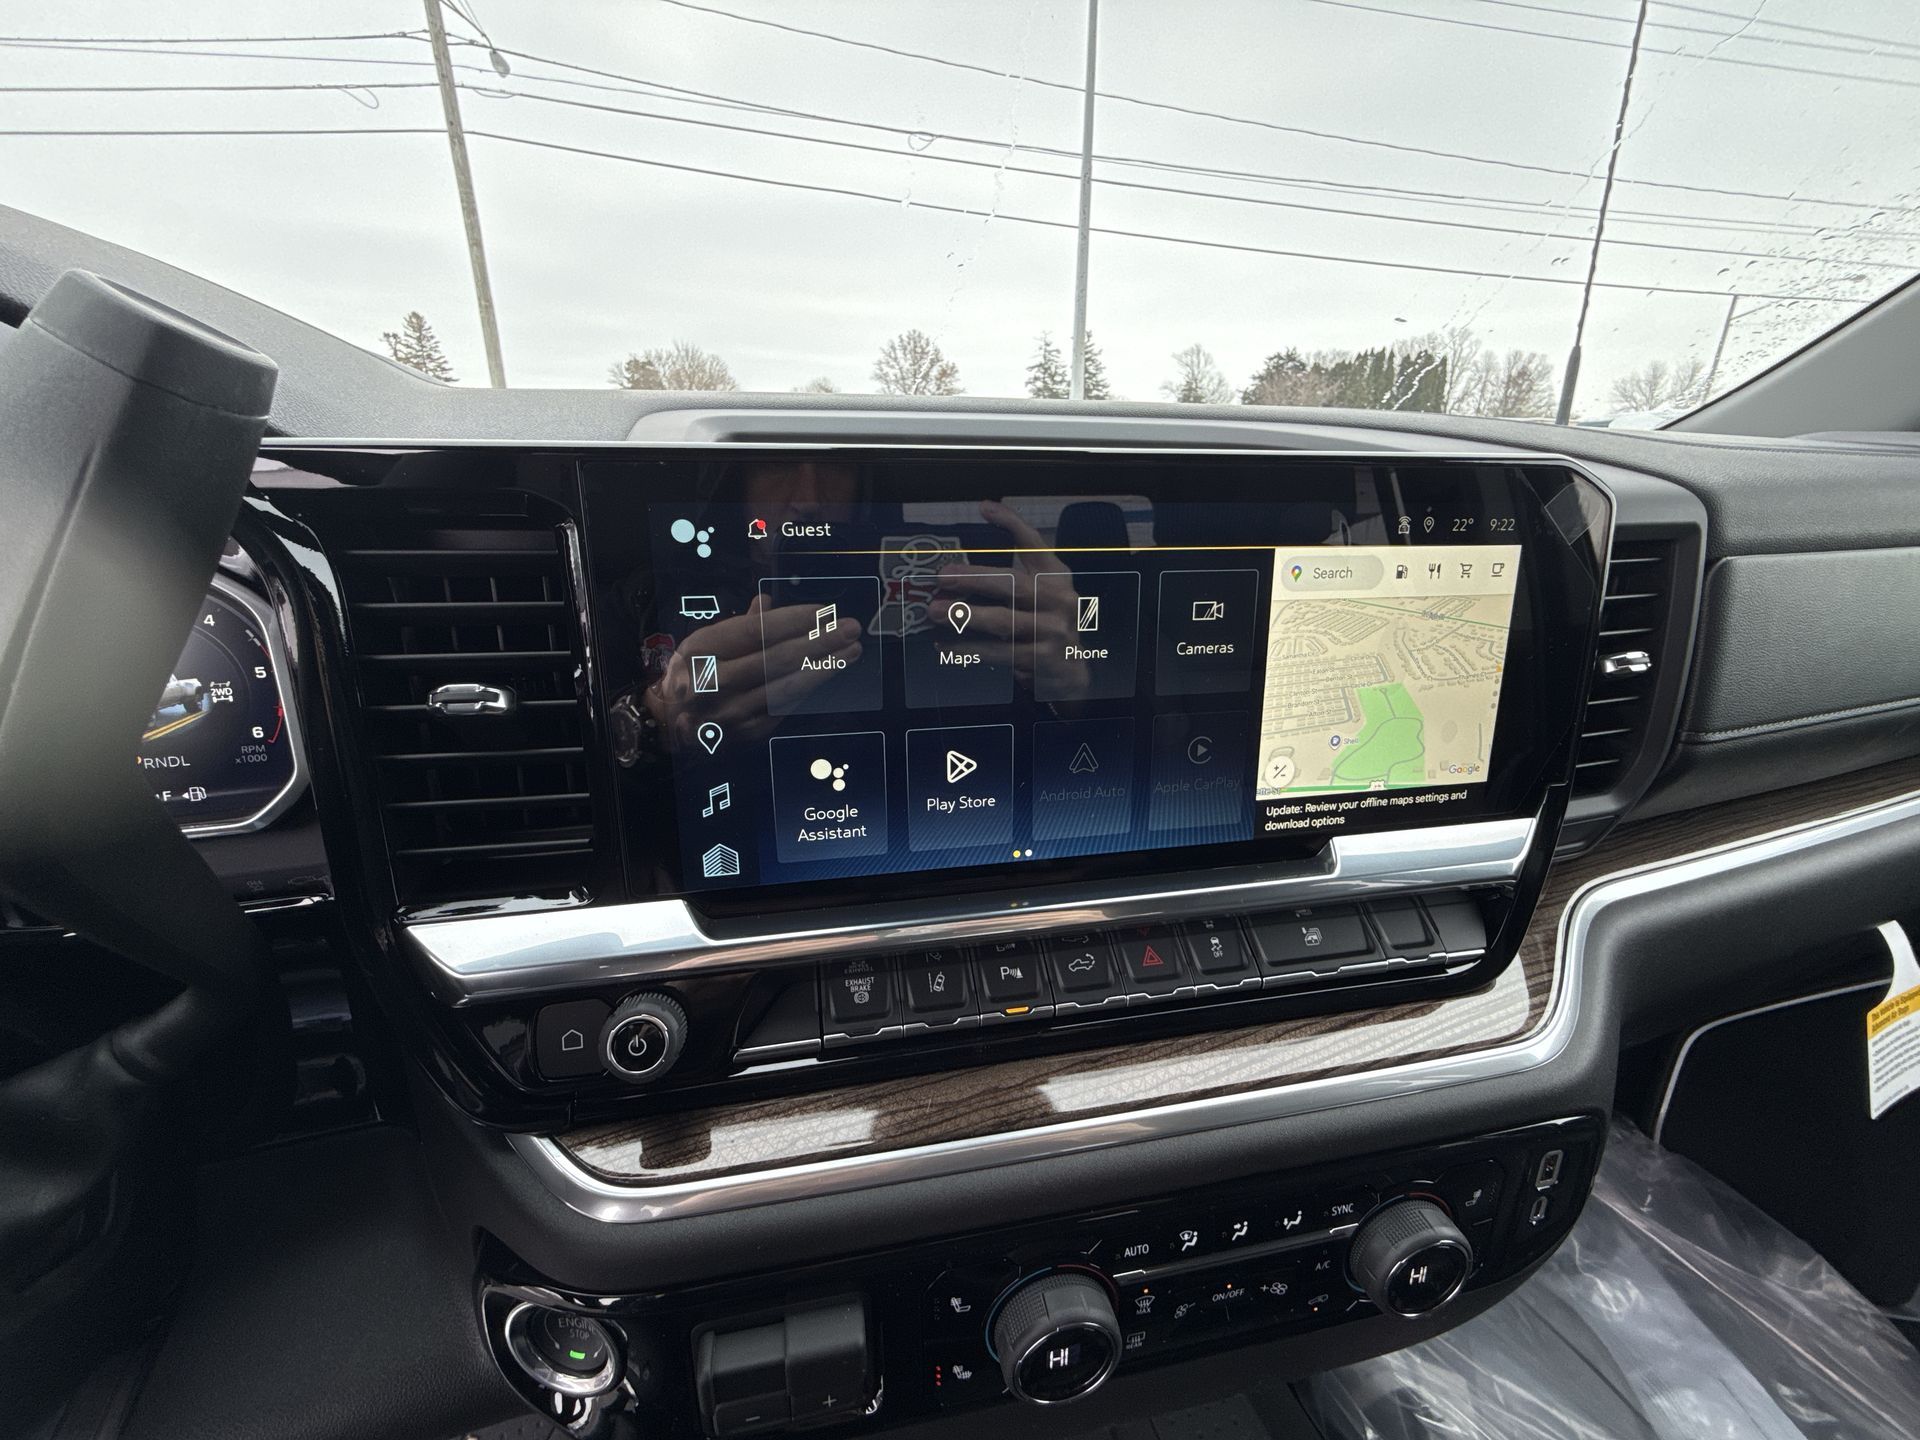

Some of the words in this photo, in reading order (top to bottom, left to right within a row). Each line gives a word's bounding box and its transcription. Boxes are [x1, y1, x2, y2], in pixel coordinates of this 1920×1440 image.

[781, 521, 832, 538] Guest
[1452, 518, 1474, 532] 22°
[1490, 518, 1515, 532] 9:22
[1312, 566, 1353, 580] Search
[203, 614, 216, 627] 4
[1065, 646, 1109, 660] Phone
[1176, 641, 1234, 656] Cameras
[800, 655, 847, 671] Audio
[939, 651, 981, 668] Maps
[254, 666, 267, 679] 5
[211, 688, 233, 697] 2WD
[252, 726, 264, 739] 6
[241, 744, 265, 754] RPM
[235, 753, 267, 764] x1000
[1448, 764, 1480, 775] Google
[1154, 780, 1190, 796] Apple
[1193, 775, 1240, 791] CarPlay
[163, 790, 171, 801] F
[1039, 788, 1092, 802] Android
[1094, 785, 1125, 798] Auto
[927, 797, 956, 813] Play
[959, 795, 996, 810] Store
[1266, 804, 1303, 817] Update:
[1305, 802, 1336, 813] Review
[1338, 800, 1359, 812] your
[1360, 797, 1388, 808] offline
[1389, 796, 1414, 807] maps
[1415, 792, 1449, 806] settings
[1450, 790, 1467, 801] and
[804, 803, 859, 823] Google
[1265, 818, 1310, 831] download
[1311, 815, 1345, 828] options
[798, 825, 867, 842] Assistant
[845, 976, 875, 988] EXHAUST
[850, 983, 871, 993] BRAKE
[1331, 1203, 1354, 1217] SYNC
[1124, 1243, 1149, 1258] AUTO
[1315, 1260, 1331, 1272] A/C
[1409, 1265, 1427, 1286] HI
[1212, 1288, 1245, 1302] ON/OFF
[1136, 1306, 1151, 1315] MAX
[558, 1317, 597, 1336] ENGINE
[569, 1328, 590, 1340] STOP
[1049, 1347, 1069, 1370] HI
